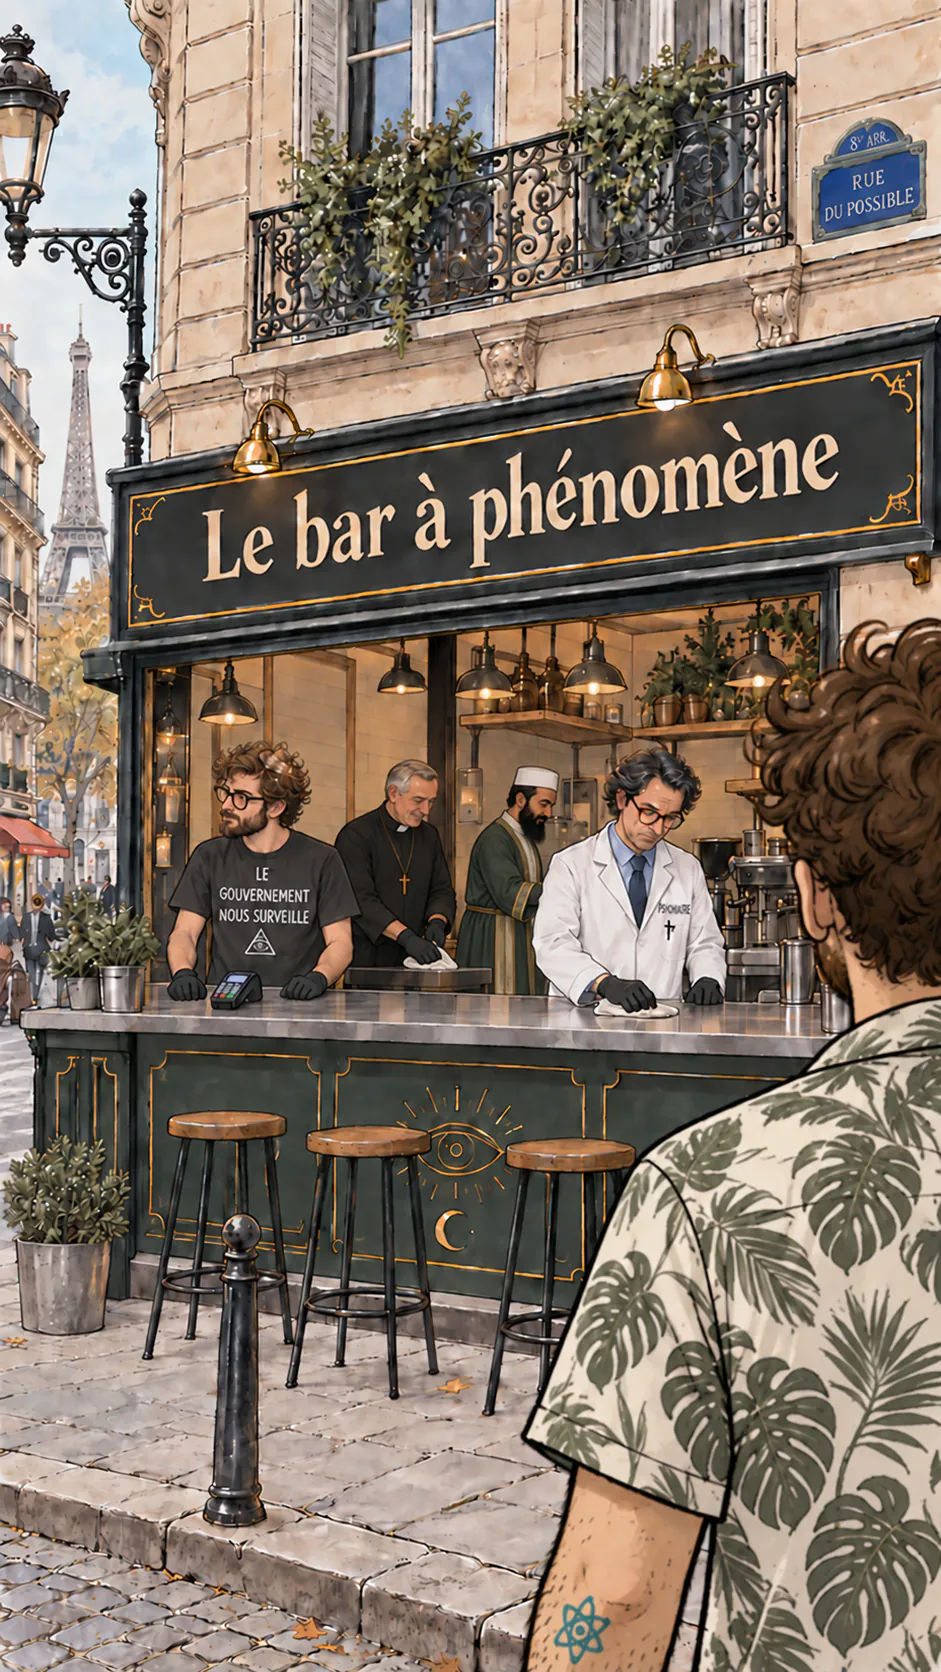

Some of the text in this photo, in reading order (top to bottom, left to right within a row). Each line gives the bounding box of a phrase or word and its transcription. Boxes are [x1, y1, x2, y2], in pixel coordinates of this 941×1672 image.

[852, 169, 885, 190] RUE
[825, 187, 914, 222] DU POSSIBLE
[202, 421, 839, 582] Le bar à phénomène
[255, 866, 270, 882] LE
[219, 886, 310, 903] GOUVERNEMENT
[219, 908, 310, 925] NOUS SURVEILLE
